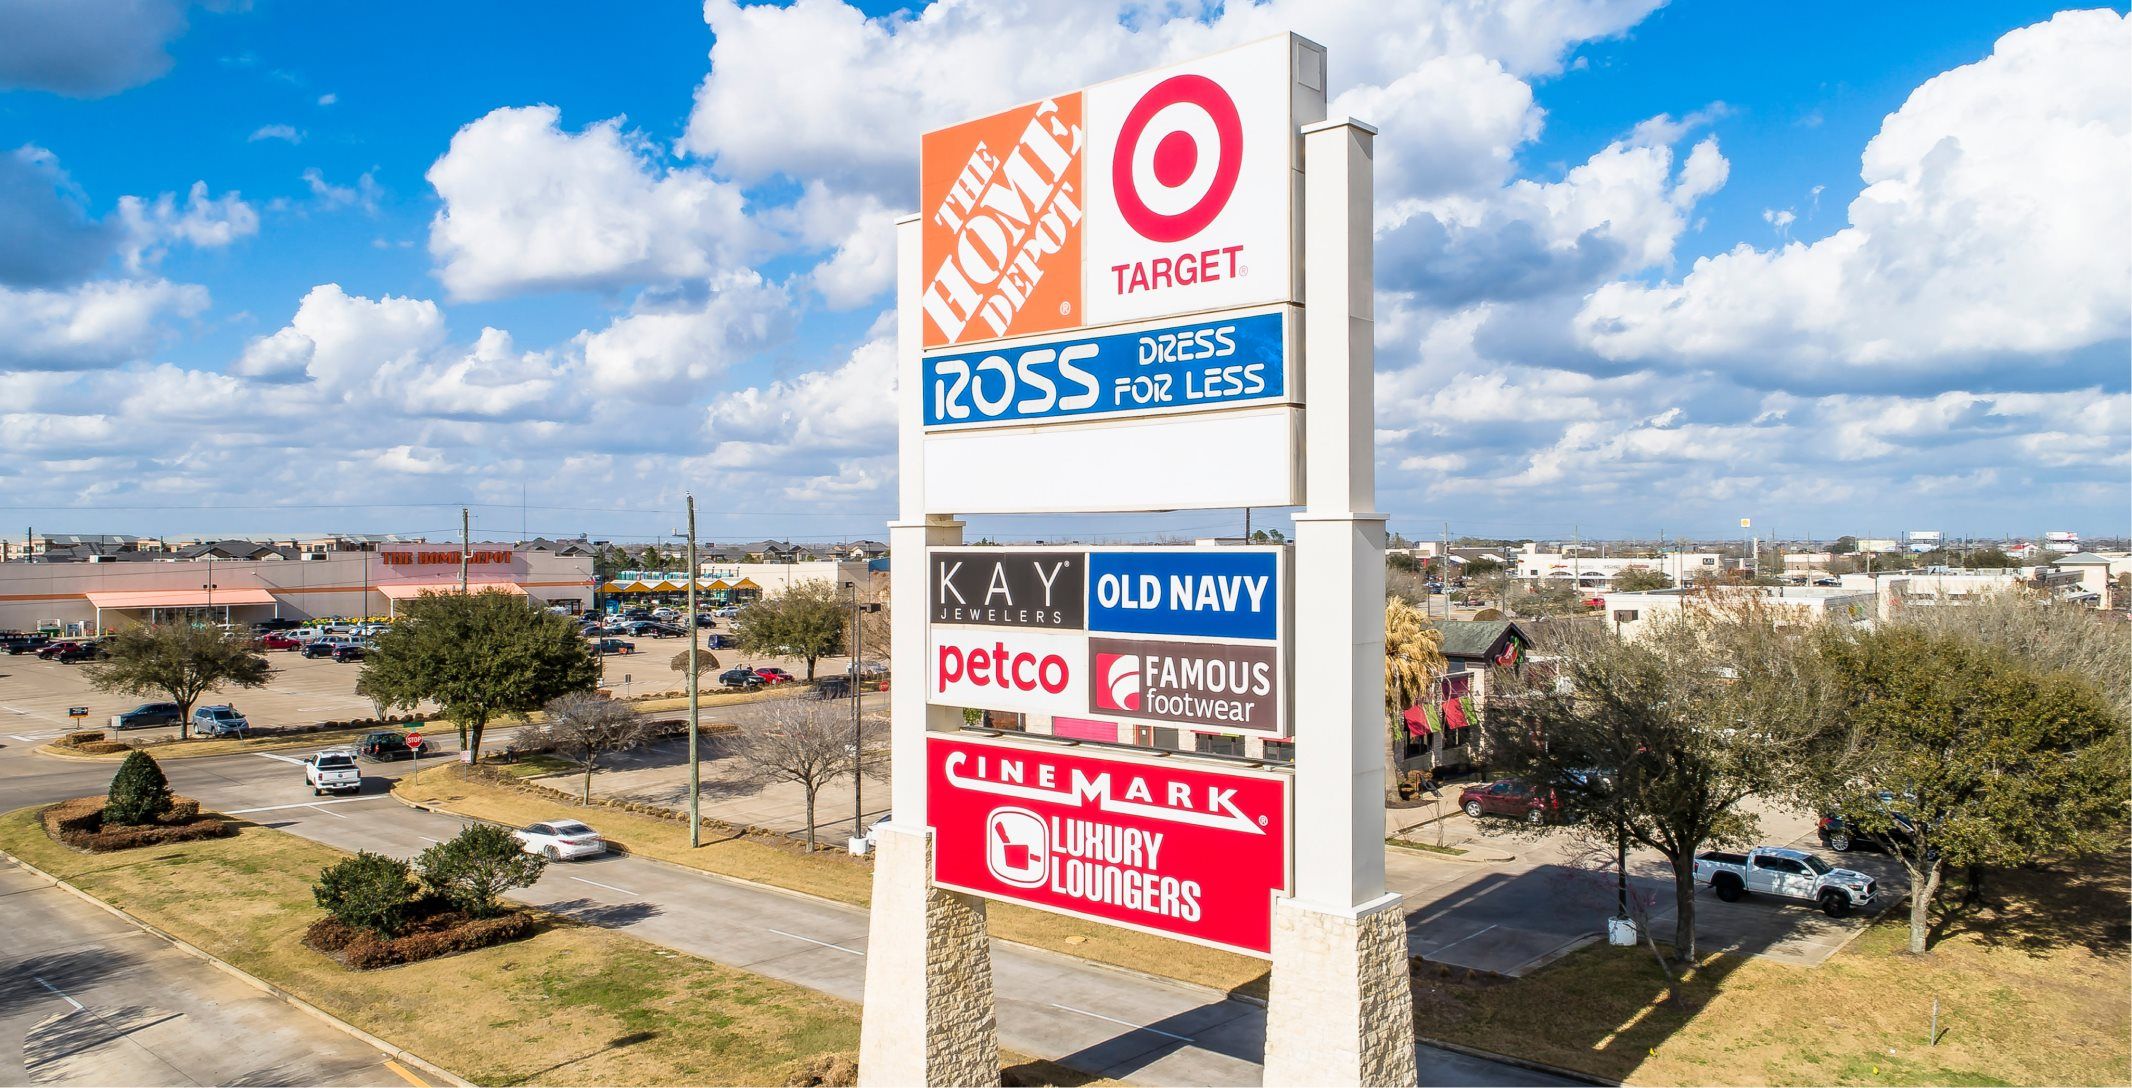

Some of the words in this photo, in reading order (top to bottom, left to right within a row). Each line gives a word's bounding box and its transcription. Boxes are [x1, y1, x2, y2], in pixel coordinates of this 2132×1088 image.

[934, 140, 1000, 235] THE
[922, 99, 1083, 344] HOME
[979, 181, 1083, 337] DEPOT
[1111, 245, 1244, 295] TARGET
[1138, 325, 1236, 366] DRESS
[934, 344, 1100, 421] ROSS
[1114, 373, 1173, 406] FOR
[1186, 363, 1265, 399] LESS
[381, 551, 414, 565] THE
[940, 561, 1063, 607] KAY
[1096, 573, 1162, 610] OLD
[1170, 575, 1269, 613] NAVY
[940, 608, 1062, 624] JEWELERS
[939, 641, 1070, 694] petco
[1146, 654, 1271, 697] FAMOUS
[1146, 688, 1255, 722] footwear
[407, 736, 422, 744] STOP
[1051, 815, 1164, 870] LUXURY
[1051, 855, 1201, 922] LOUNGERS
